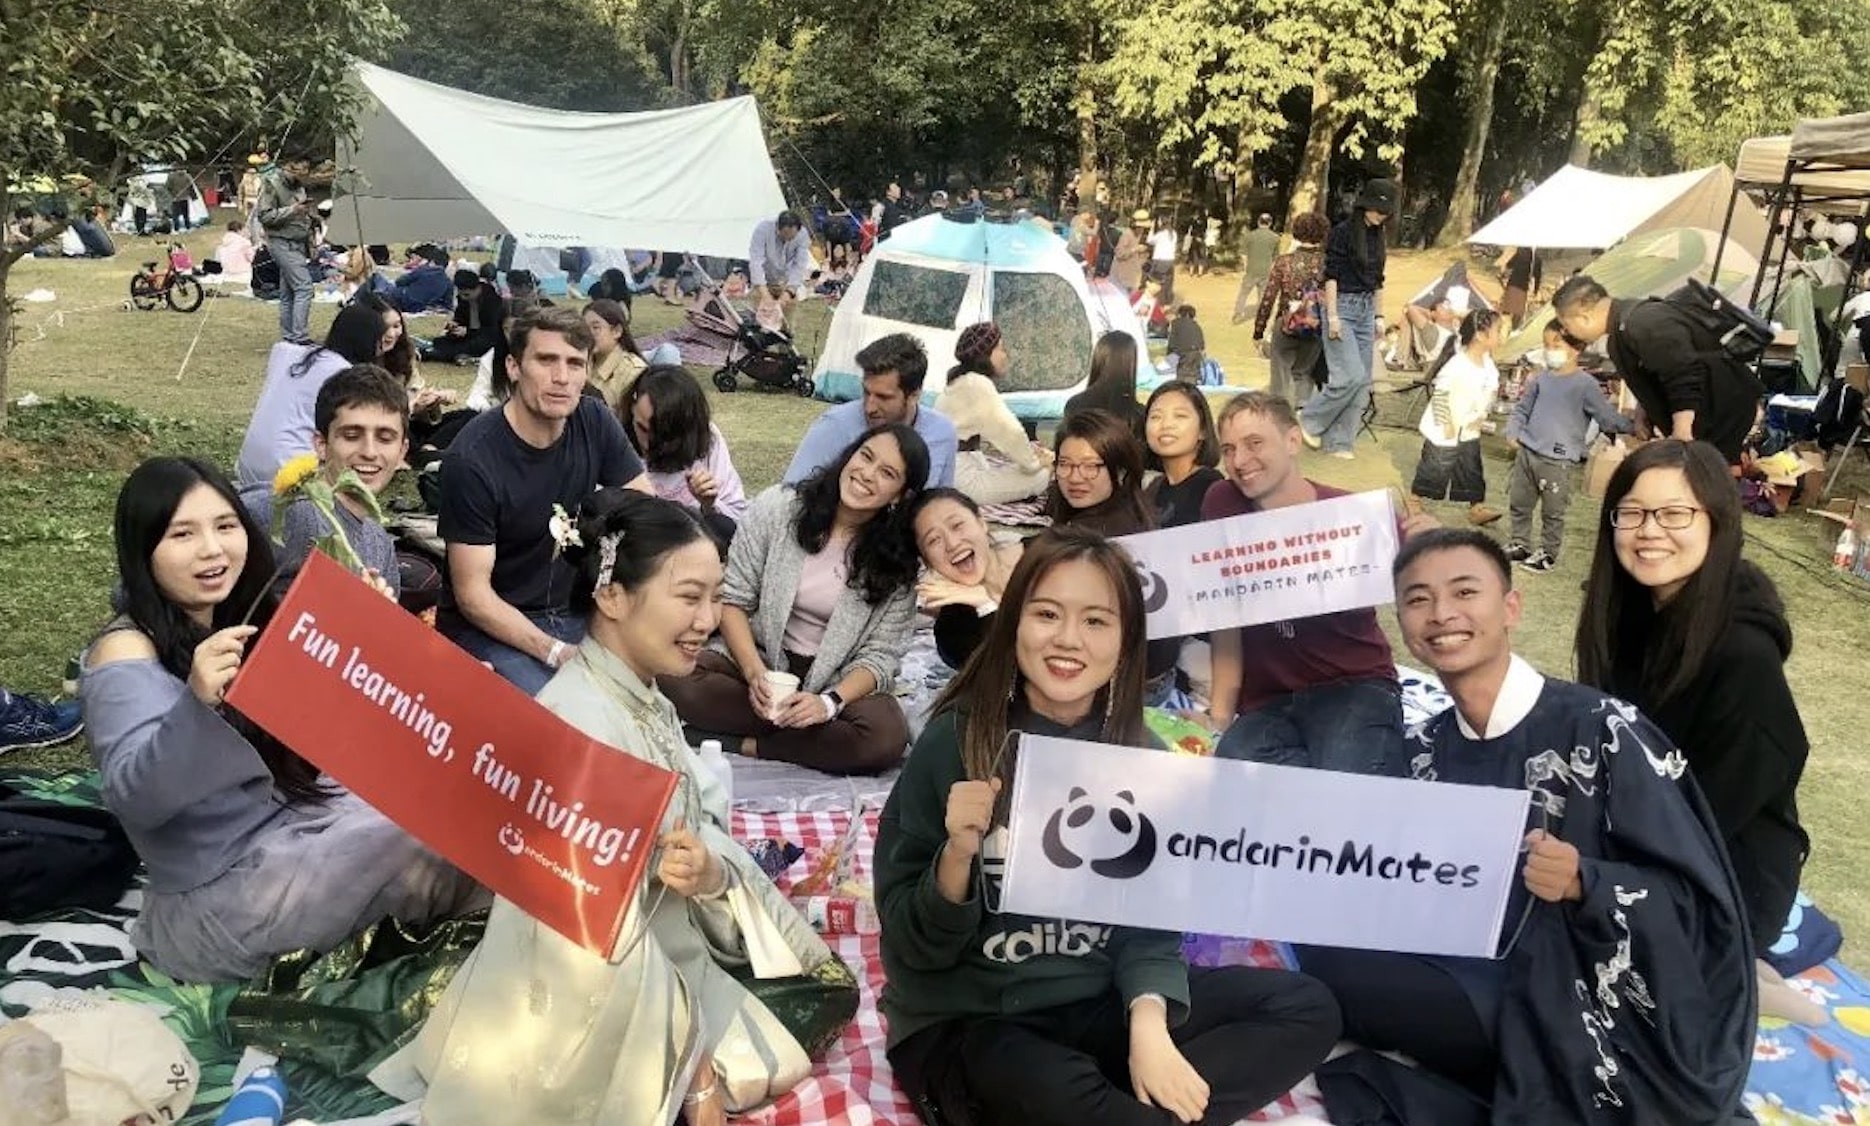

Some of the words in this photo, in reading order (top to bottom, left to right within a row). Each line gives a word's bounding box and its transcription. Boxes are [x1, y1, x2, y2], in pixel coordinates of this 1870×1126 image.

[1190, 540, 1278, 565] LEARNING
[1284, 524, 1364, 549] WITHOUT
[1219, 549, 1333, 578] BOUNDARIES
[287, 611, 340, 668] Fun
[341, 646, 455, 763] learning,
[472, 742, 521, 802] fun
[526, 778, 641, 867] living!
